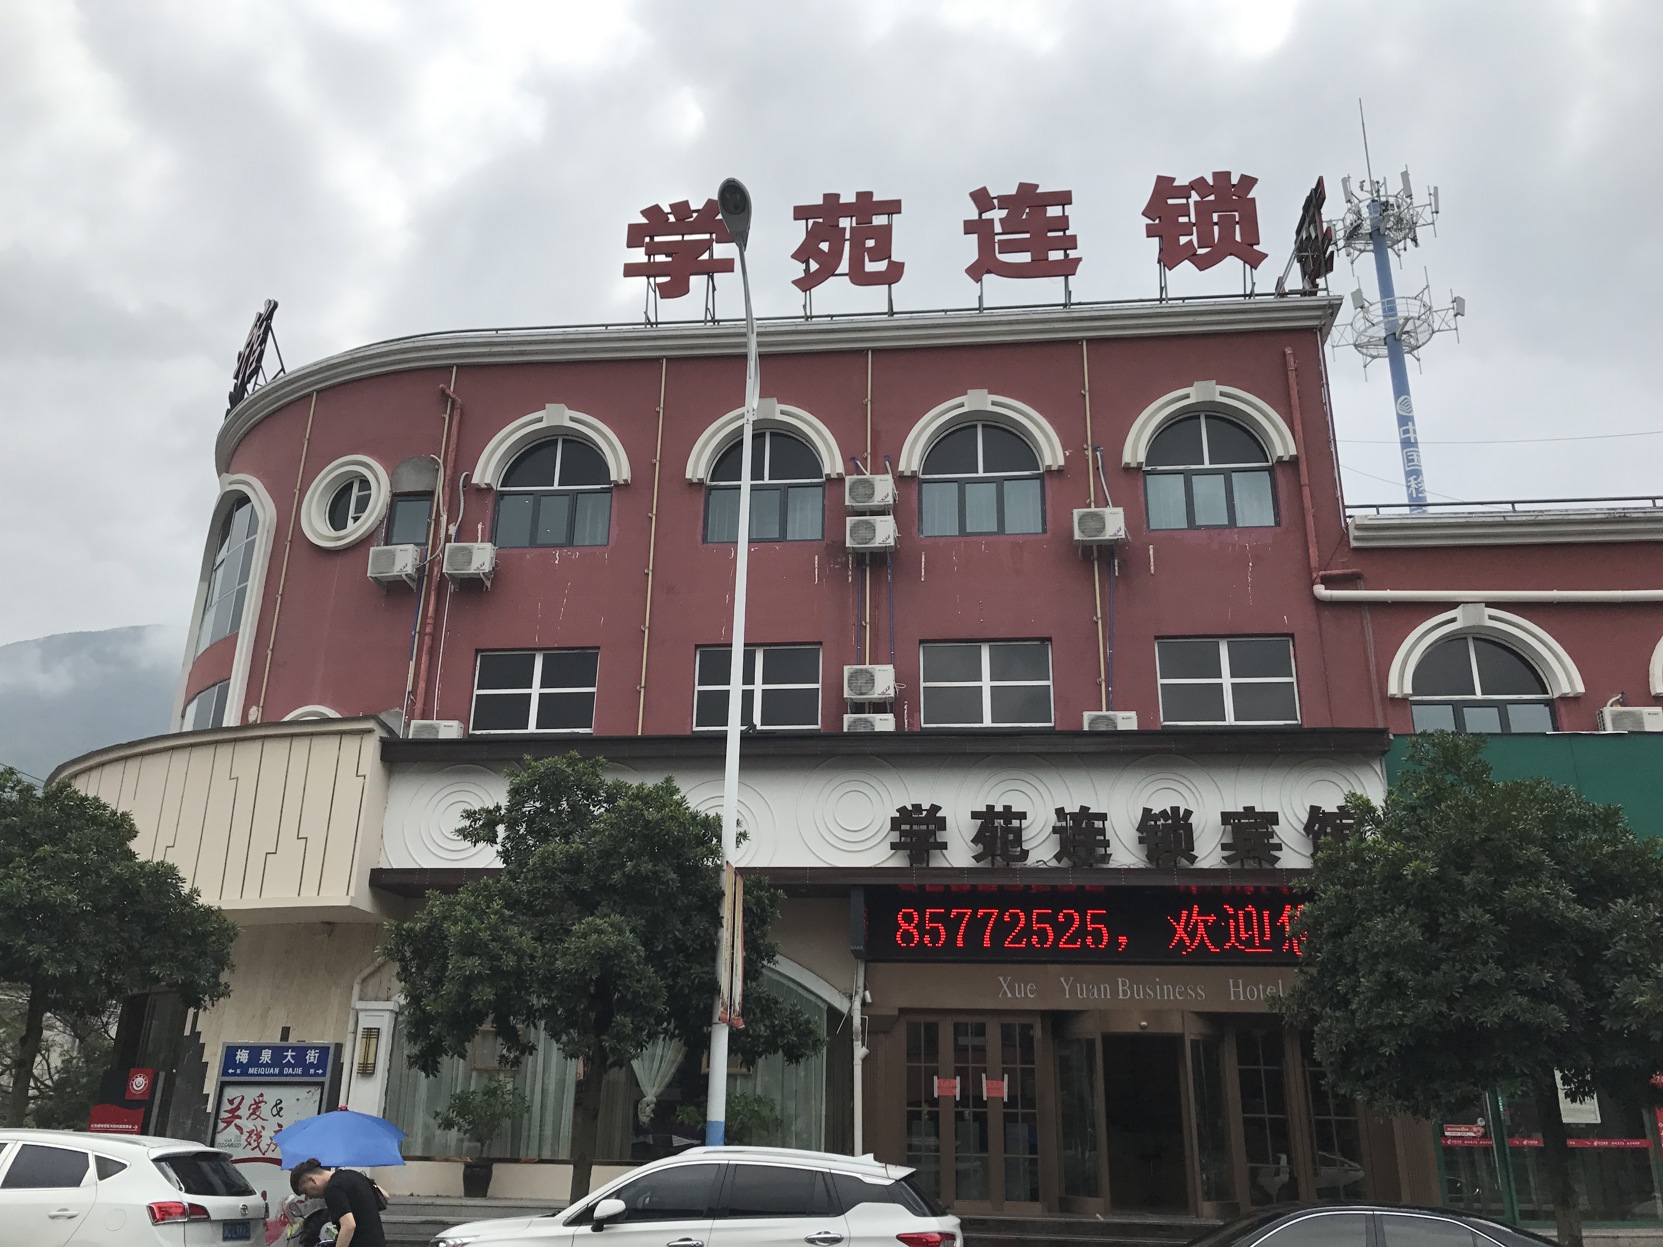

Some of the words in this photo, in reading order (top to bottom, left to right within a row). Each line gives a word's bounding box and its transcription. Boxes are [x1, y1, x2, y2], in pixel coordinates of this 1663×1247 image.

[623, 171, 1268, 299] 学苑连锁
[1400, 421, 1428, 513] 中国移
[998, 976, 1037, 999] Xue
[1060, 976, 1110, 1000] Yuan
[1118, 977, 1206, 1001] Business
[235, 1048, 320, 1064] 梅泉大街
[248, 1067, 280, 1075] MEIQUAN
[283, 1067, 303, 1075] DAJIE
